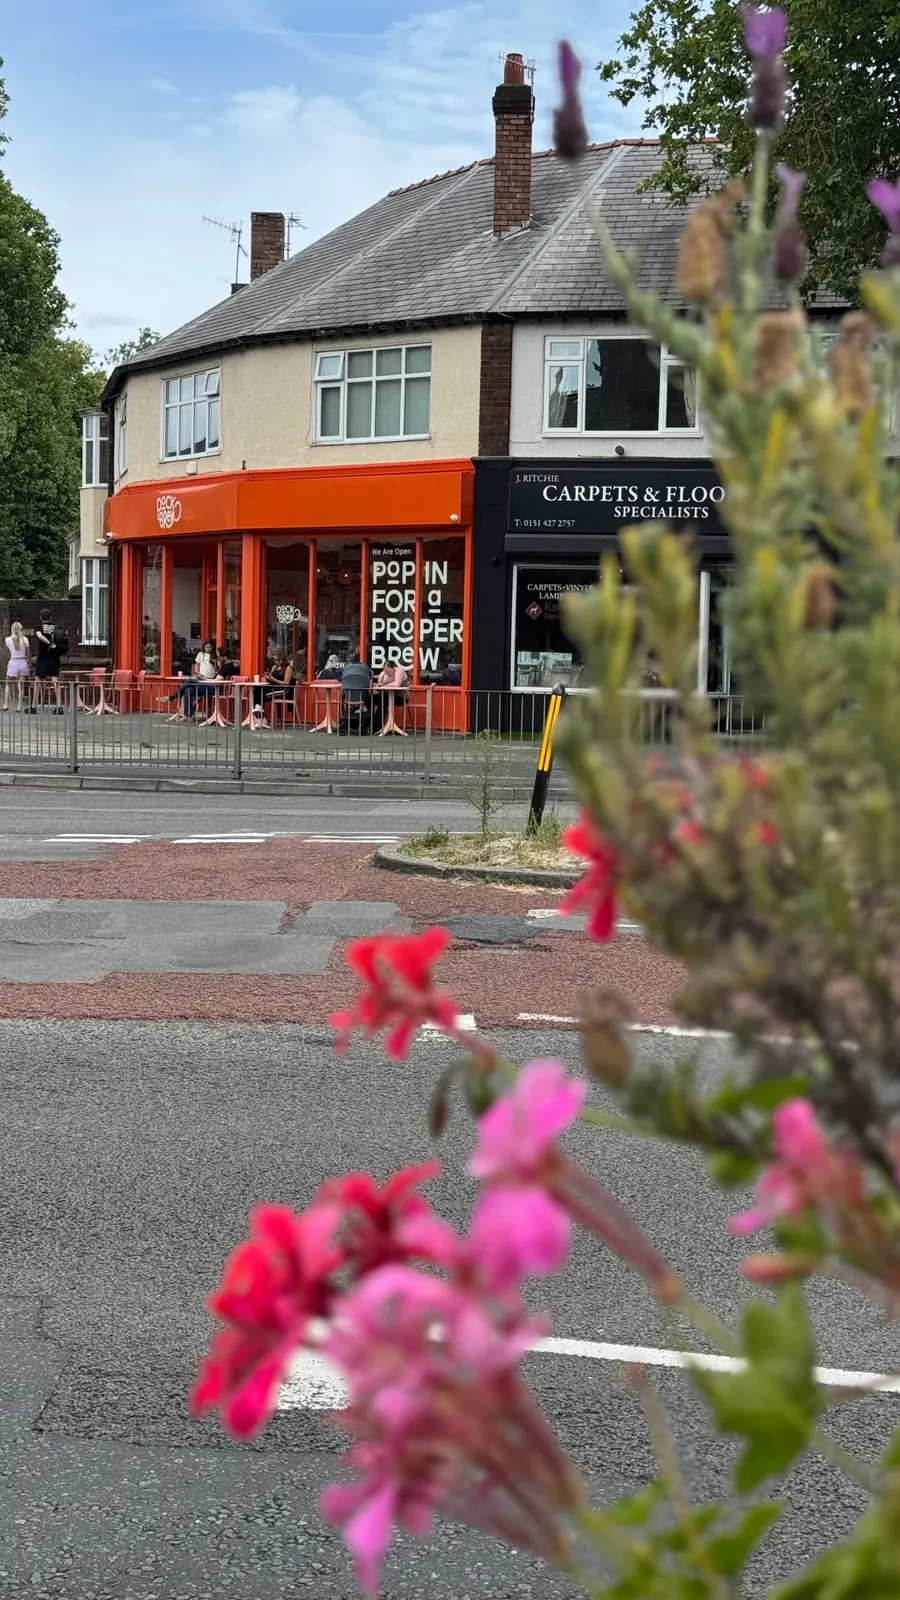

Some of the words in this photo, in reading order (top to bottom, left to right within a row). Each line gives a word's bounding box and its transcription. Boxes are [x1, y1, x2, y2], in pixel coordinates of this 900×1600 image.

[522, 474, 560, 483] RITCHIE
[542, 485, 639, 502] CARPETS
[643, 486, 661, 502] &
[665, 486, 726, 503] FLOO
[613, 506, 709, 518] SPECIALISTS
[523, 519, 541, 527] 0151
[542, 519, 557, 527] 427
[557, 520, 576, 528] 2757
[394, 548, 412, 556] Open
[424, 561, 449, 585] IN
[372, 589, 416, 613] FOR
